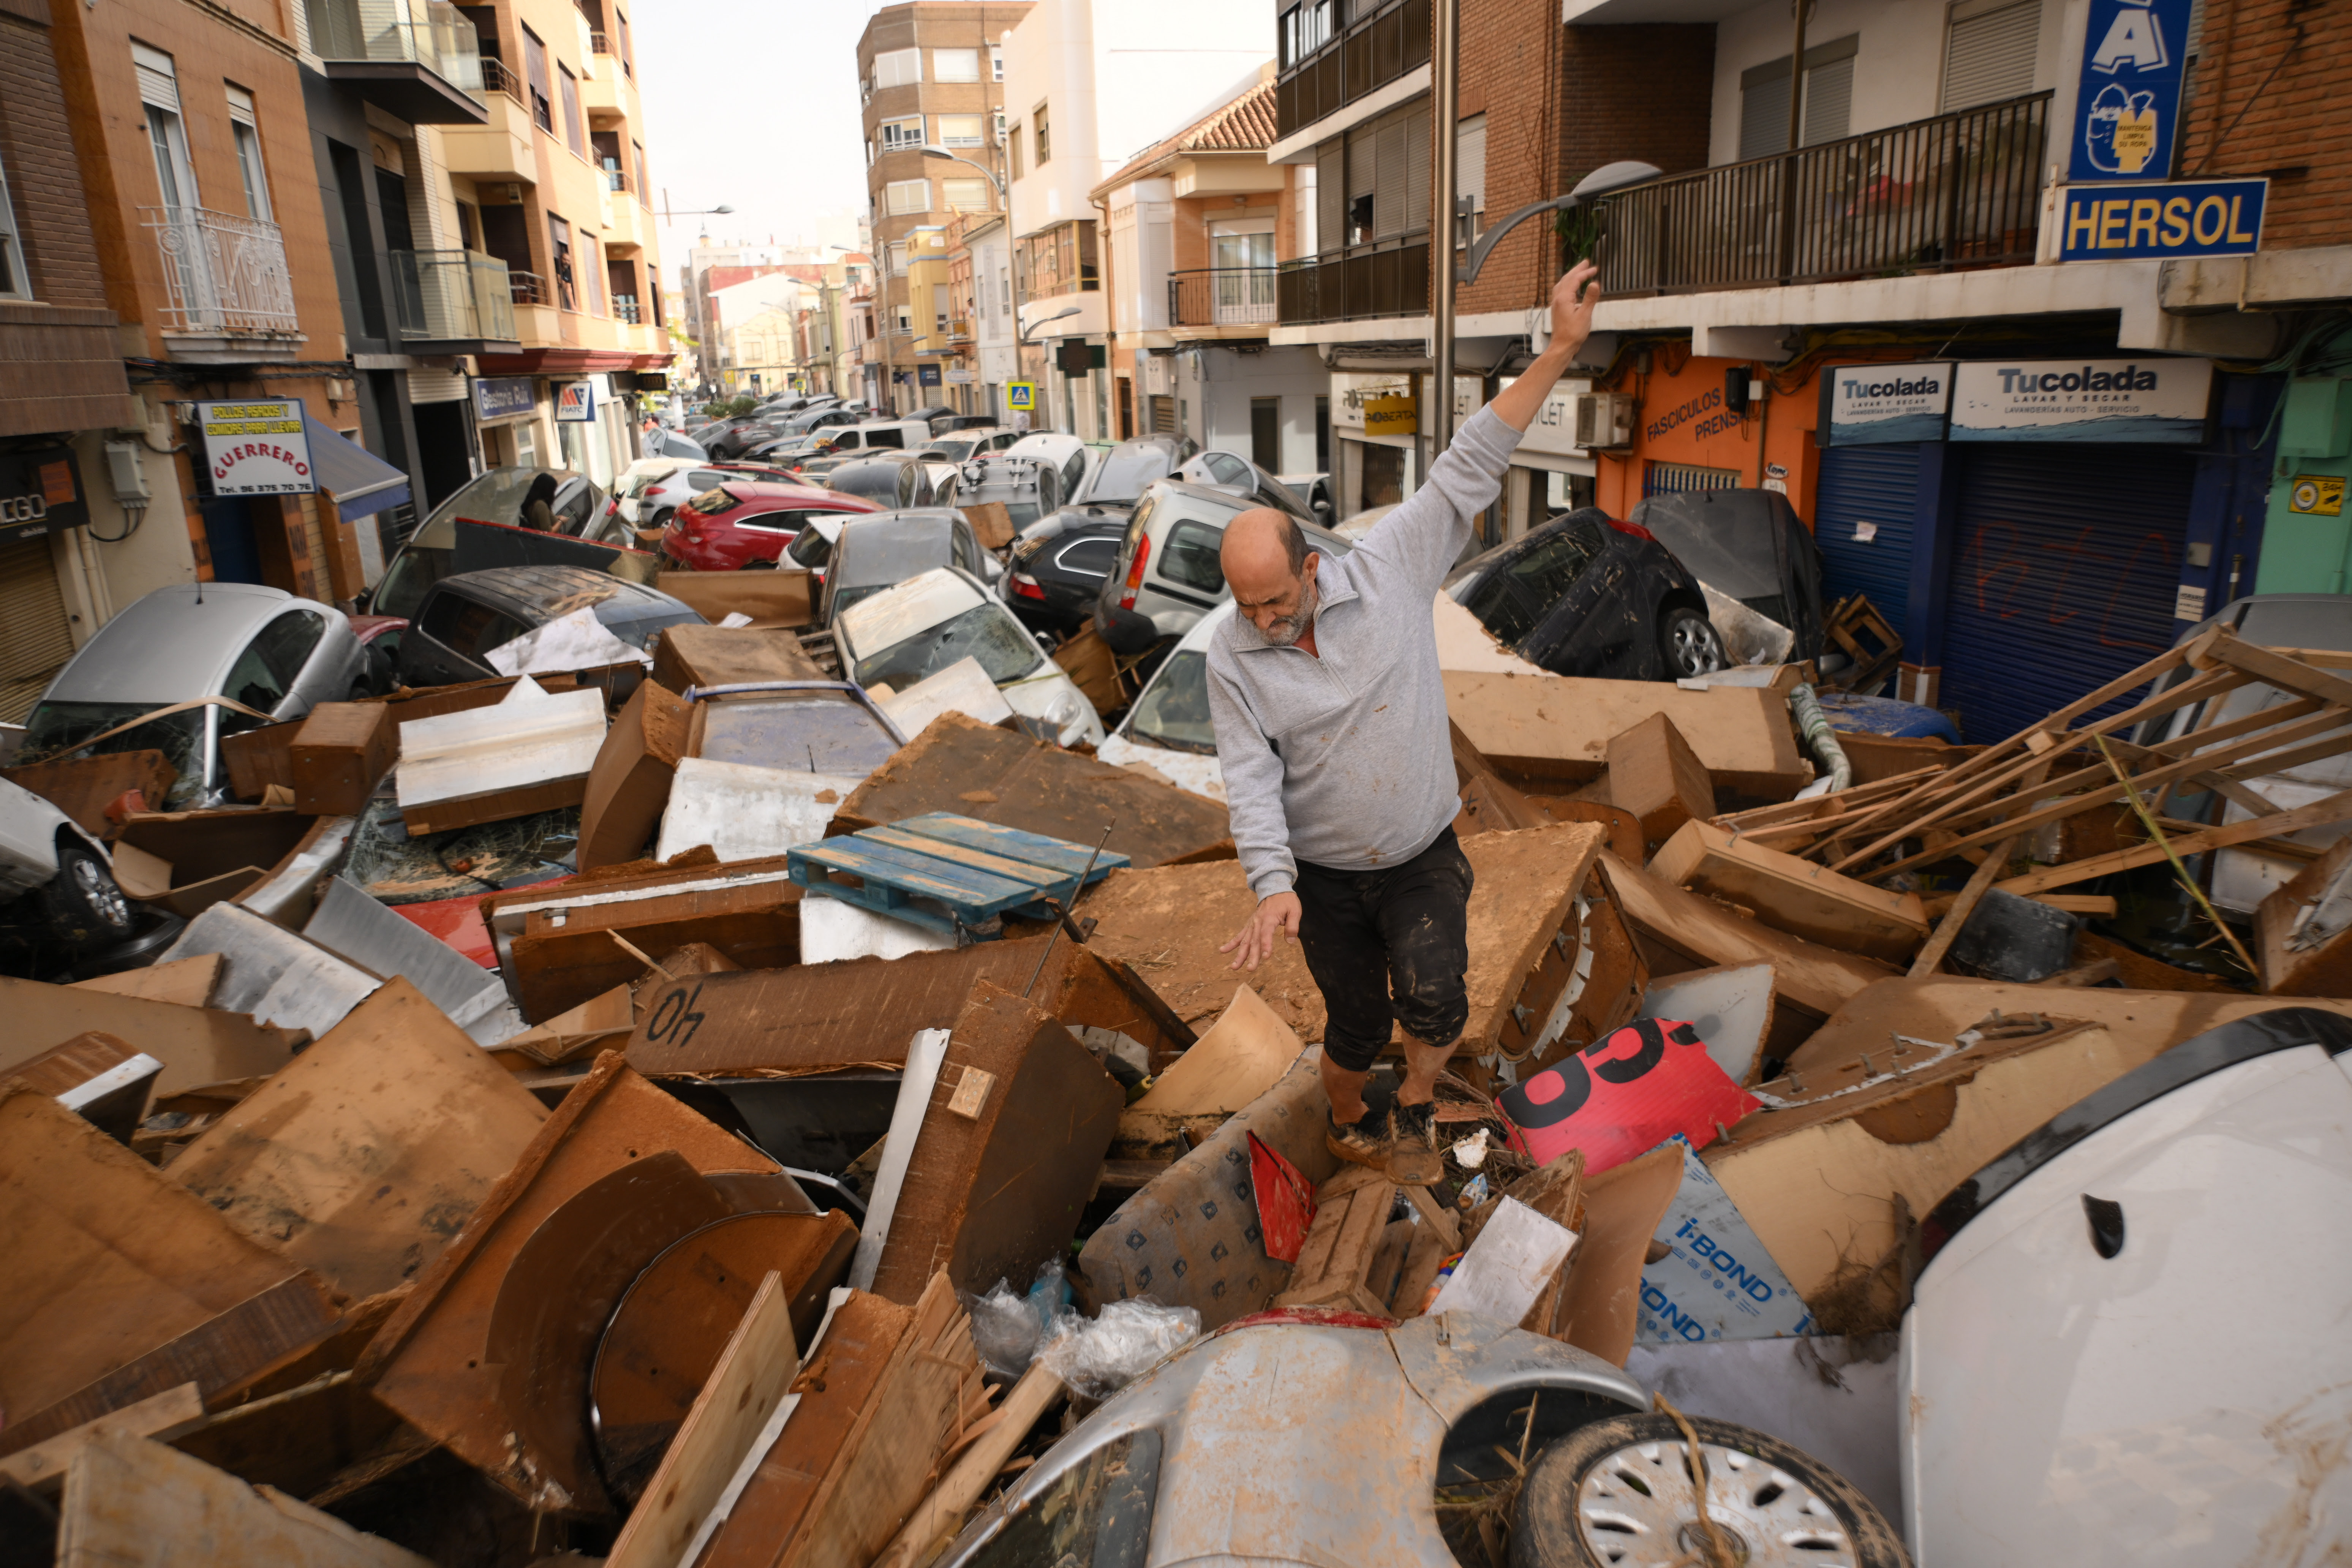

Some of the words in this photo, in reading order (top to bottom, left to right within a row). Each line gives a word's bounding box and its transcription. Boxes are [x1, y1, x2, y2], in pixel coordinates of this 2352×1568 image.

[2066, 195, 2254, 250] HERSOL
[1843, 376, 1939, 399] Tucolada
[1997, 365, 2158, 393] Tucolada
[212, 405, 245, 419] POLLOS
[247, 404, 281, 417] ASADOS
[281, 404, 289, 417] Y
[1366, 410, 1416, 423] ROBERTA
[1647, 387, 1721, 443] FASCICULOS
[2004, 405, 2062, 414] LAVANDERÍAS
[206, 422, 243, 435] COMIDAS
[245, 421, 267, 434] PARA
[269, 420, 302, 433] LLEVAR
[214, 443, 308, 479] GUERRERO
[1639, 1276, 1705, 1342] OND
